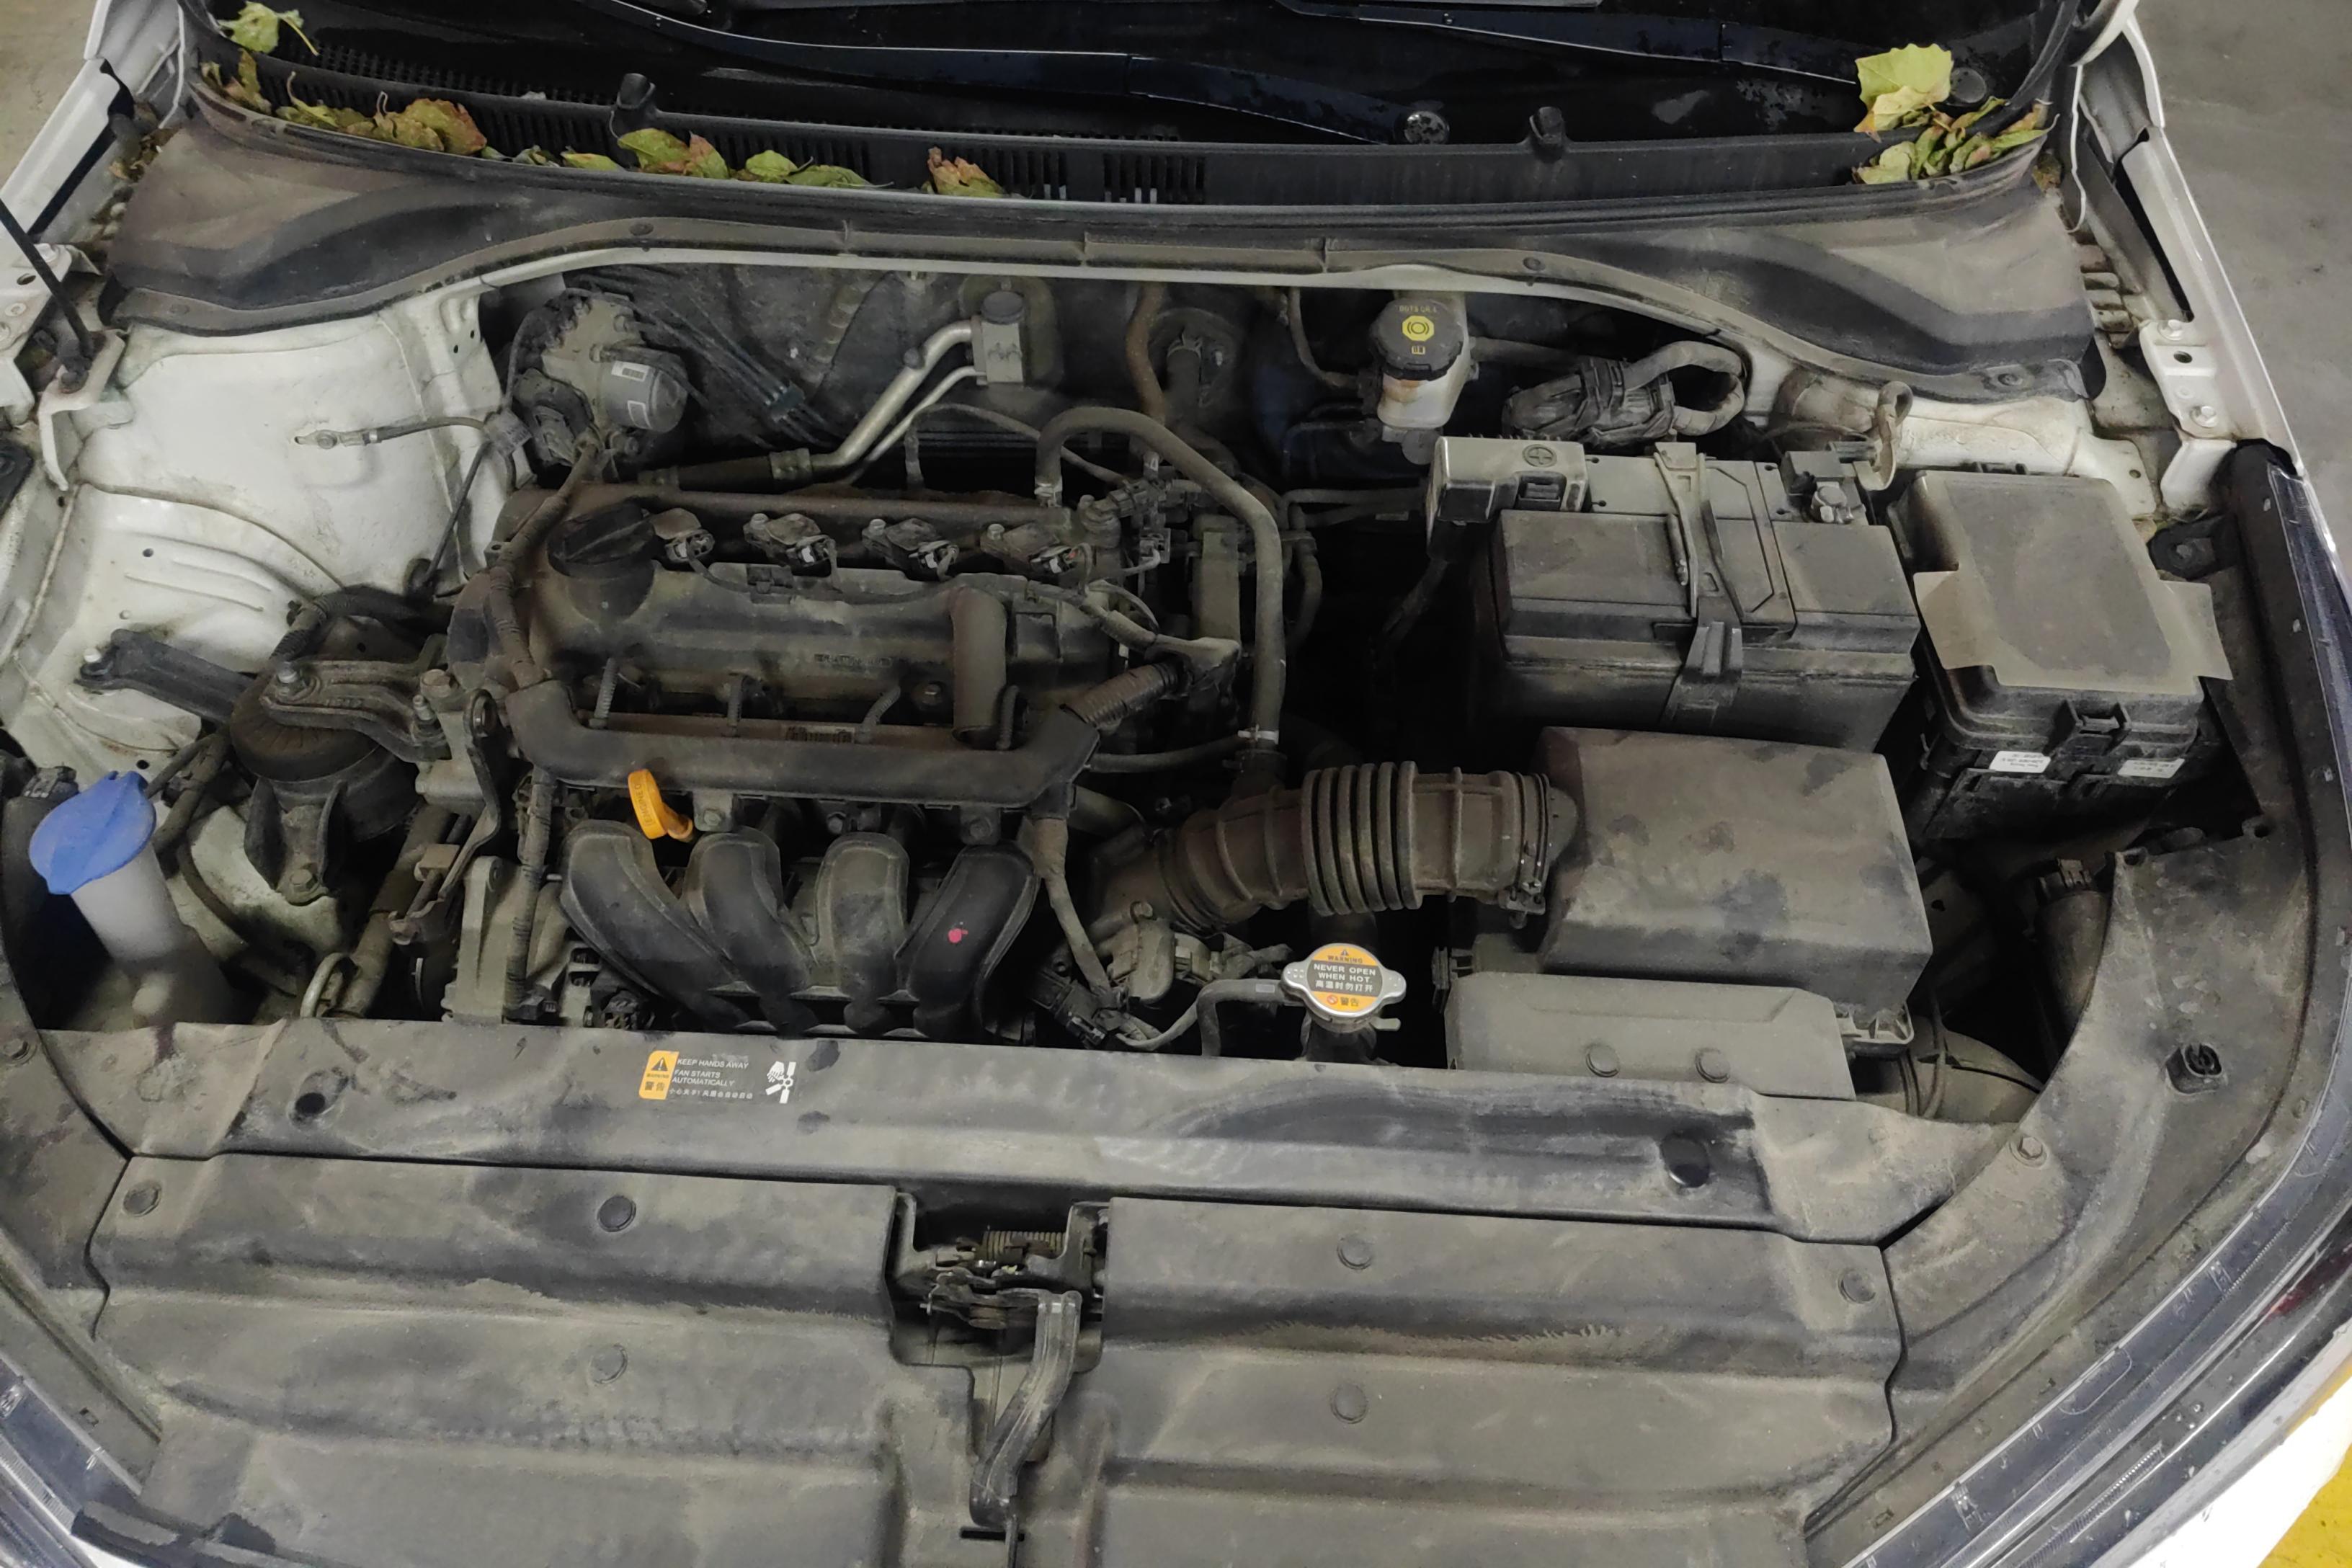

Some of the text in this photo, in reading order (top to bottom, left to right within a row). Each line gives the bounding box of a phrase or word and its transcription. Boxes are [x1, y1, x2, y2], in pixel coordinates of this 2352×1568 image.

[1328, 955, 1363, 963] WARNING
[1314, 963, 1376, 976] NEVER OPEN
[1318, 972, 1345, 981] WHEN
[1315, 980, 1373, 992] 高温时勿打开
[698, 1059, 725, 1068] HANDS
[726, 1061, 749, 1069] AWAY
[672, 1077, 735, 1087] AUTOMATICALLY
